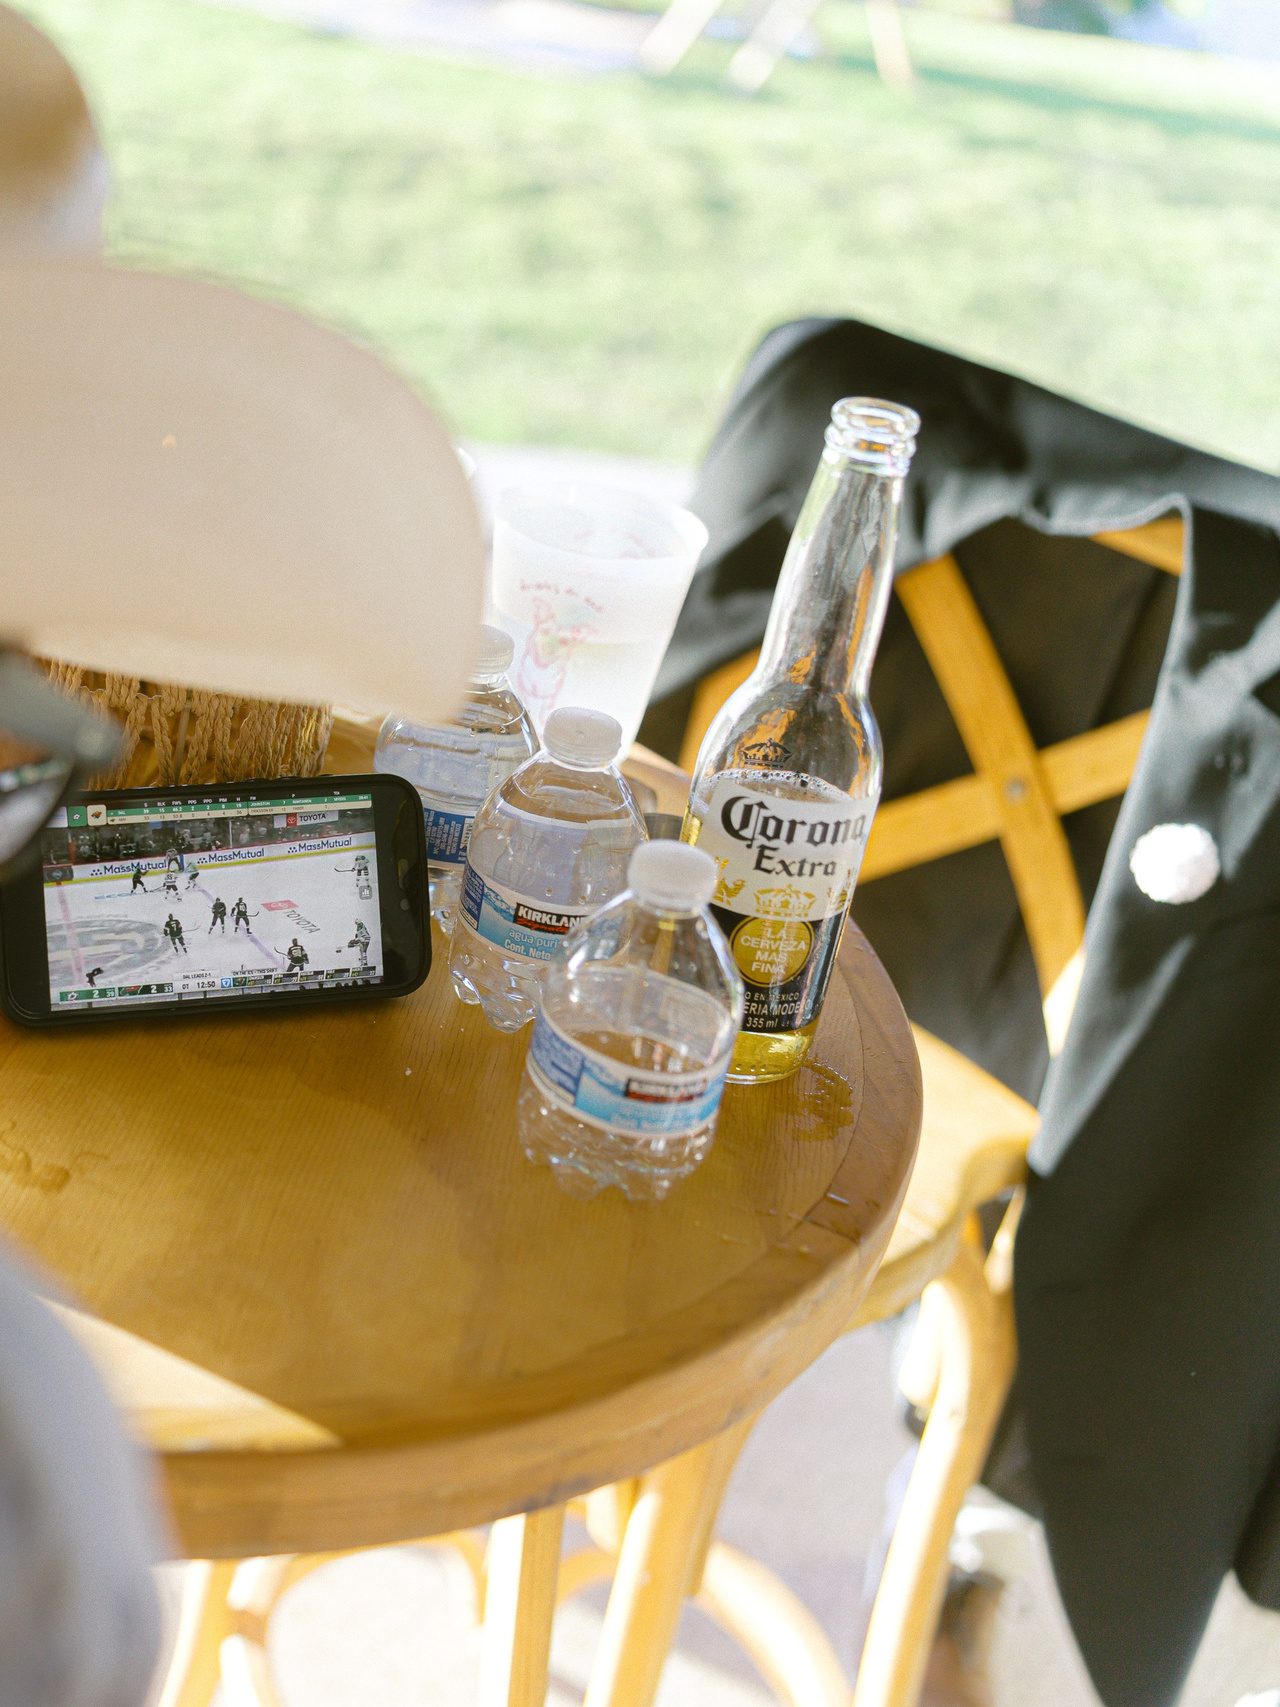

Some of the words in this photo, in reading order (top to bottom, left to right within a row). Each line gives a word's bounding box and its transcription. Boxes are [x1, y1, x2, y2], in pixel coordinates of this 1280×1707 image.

[299, 814, 327, 822] TOYOTA
[721, 796, 866, 849] Corona
[298, 837, 352, 852] MassMutual
[208, 848, 265, 863] MassMutual
[753, 844, 837, 878] Extra
[103, 859, 167, 875] MassMutual
[284, 910, 321, 934] TOYOTA
[509, 928, 534, 944] agua
[536, 938, 559, 949] puri
[767, 928, 786, 939] LA
[504, 940, 527, 955] Cont.
[529, 947, 551, 960] Neto
[740, 936, 806, 951] CERVEZA
[755, 950, 788, 961] MAS
[752, 962, 787, 975] FINA
[151, 985, 157, 993] 2
[197, 981, 216, 989] 12:50
[93, 990, 99, 998] 2
[754, 993, 766, 1001] EN
[742, 1002, 768, 1016] ERIA
[772, 999, 811, 1016] MODEO
[746, 1017, 765, 1028] 355
[766, 1018, 779, 1028] ml
